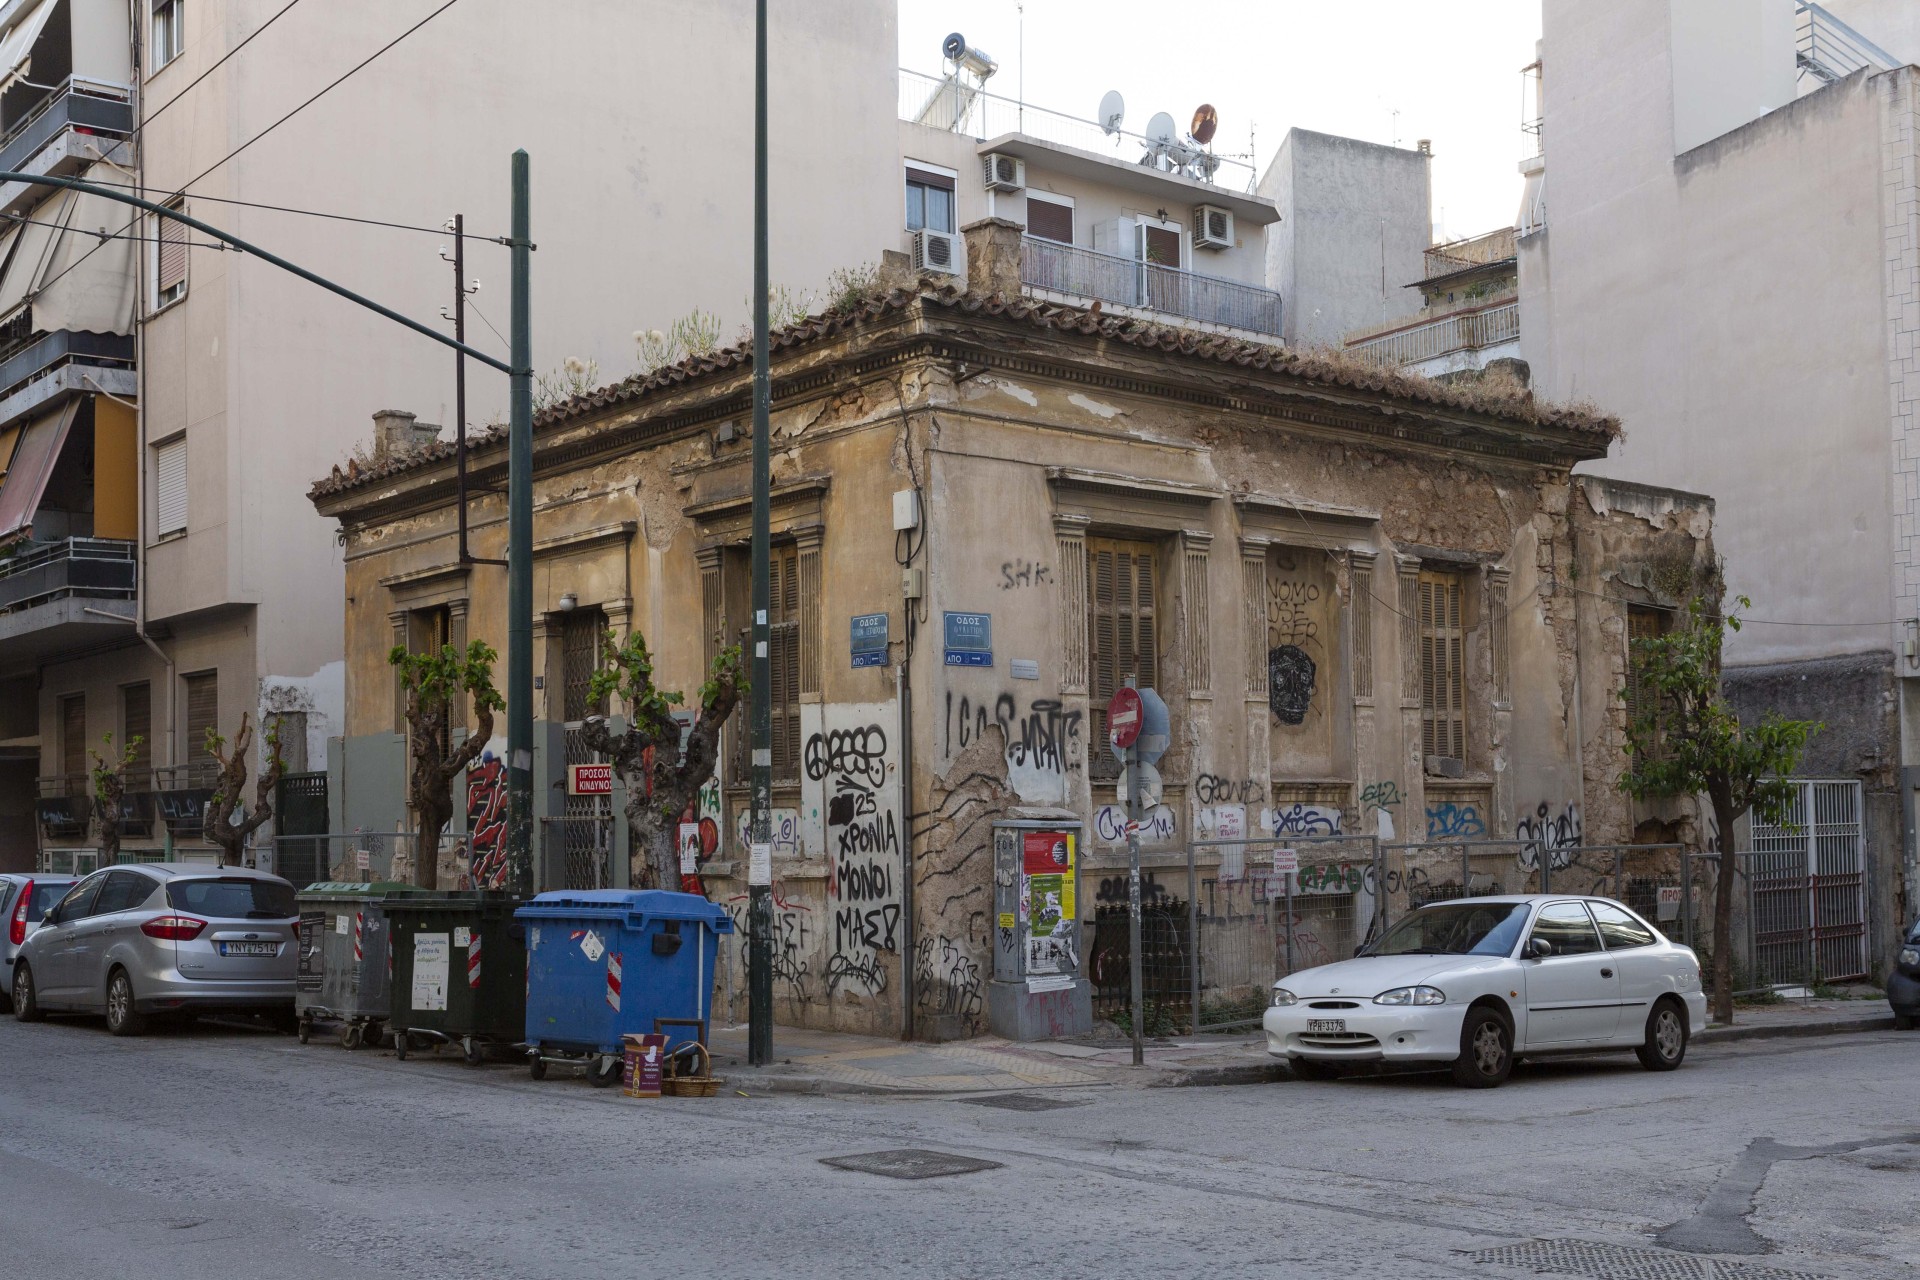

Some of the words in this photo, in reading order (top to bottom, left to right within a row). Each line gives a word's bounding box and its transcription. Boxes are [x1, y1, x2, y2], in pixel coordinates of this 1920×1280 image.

[859, 617, 879, 627] ΟΔΟΣ
[956, 616, 980, 625] ΟΔΟΣ
[852, 656, 864, 665] ΑΠΟ
[946, 654, 962, 663] ΑΠΟ
[855, 791, 877, 816] 25
[839, 809, 899, 862] ΧΡΟΝΙΑ
[837, 857, 892, 902] ΜΟΝΟΙ
